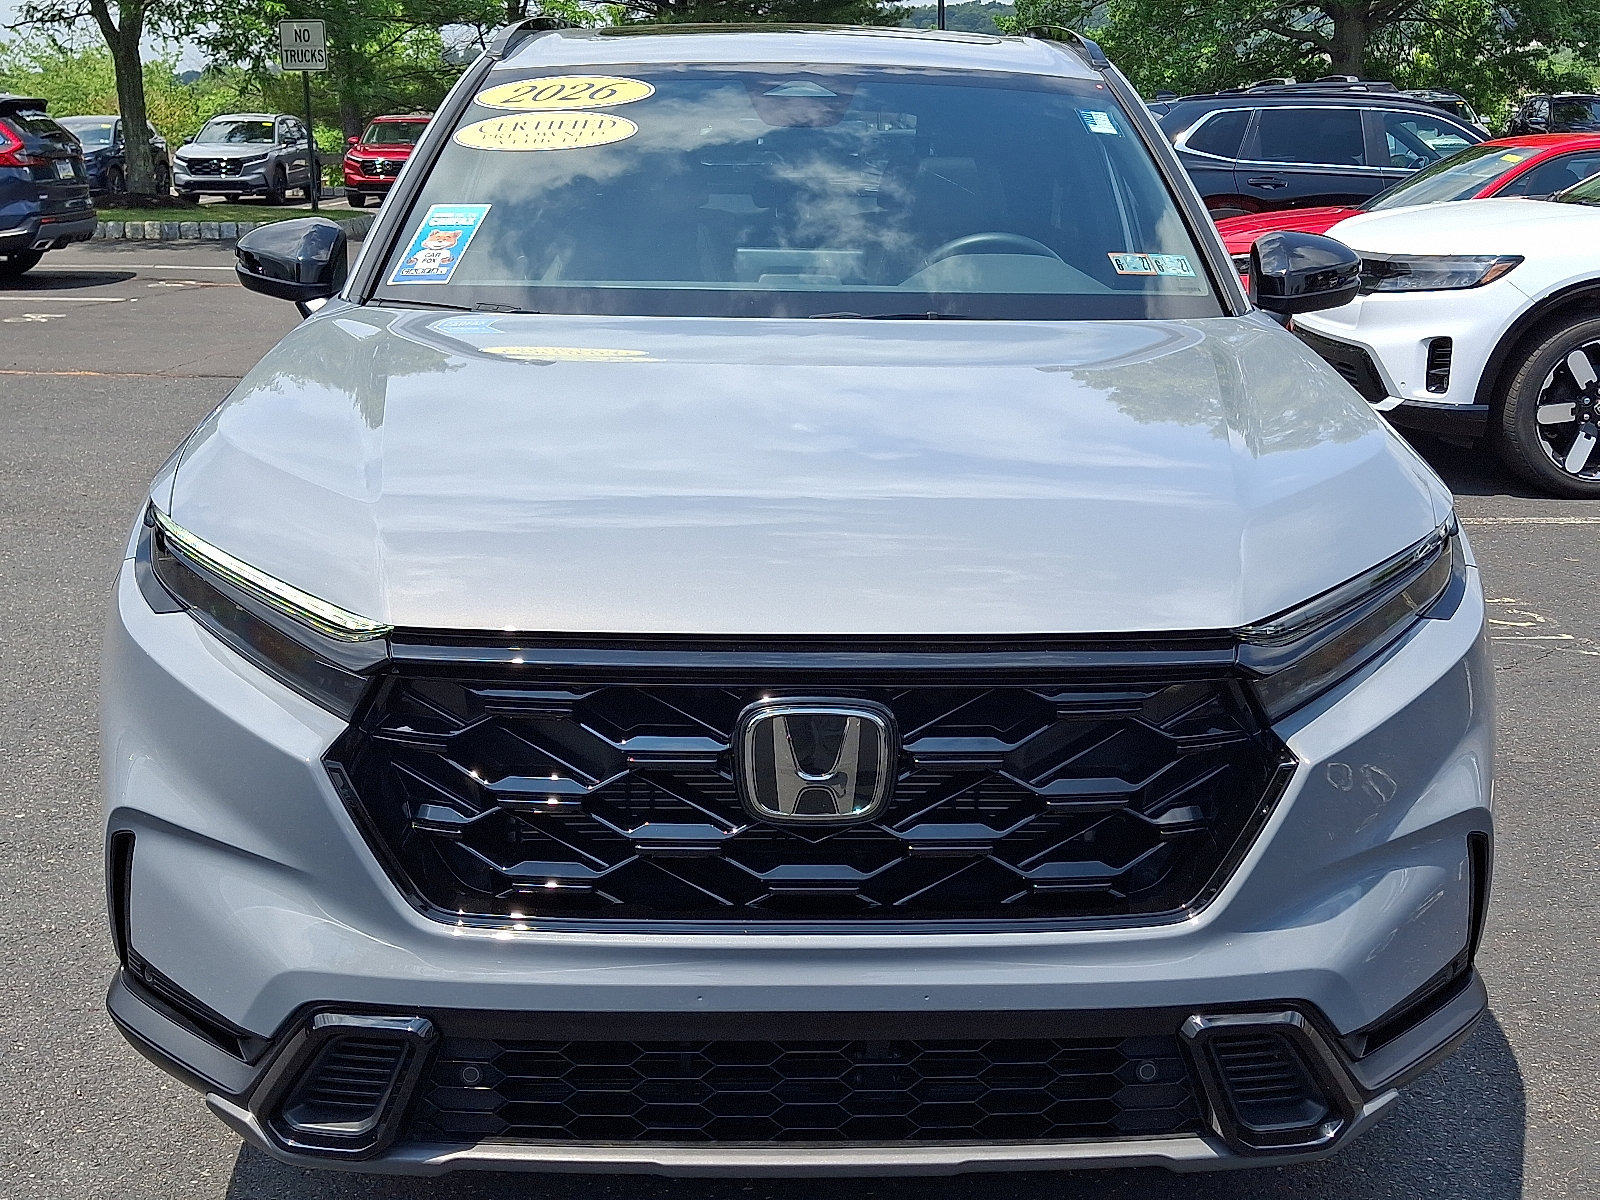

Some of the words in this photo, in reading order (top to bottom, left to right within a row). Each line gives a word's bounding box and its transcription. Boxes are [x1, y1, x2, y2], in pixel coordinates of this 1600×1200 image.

[293, 28, 311, 43] NO
[283, 48, 325, 64] TRUCKS
[500, 82, 628, 104] 2026
[478, 118, 618, 134] CERTIFIED
